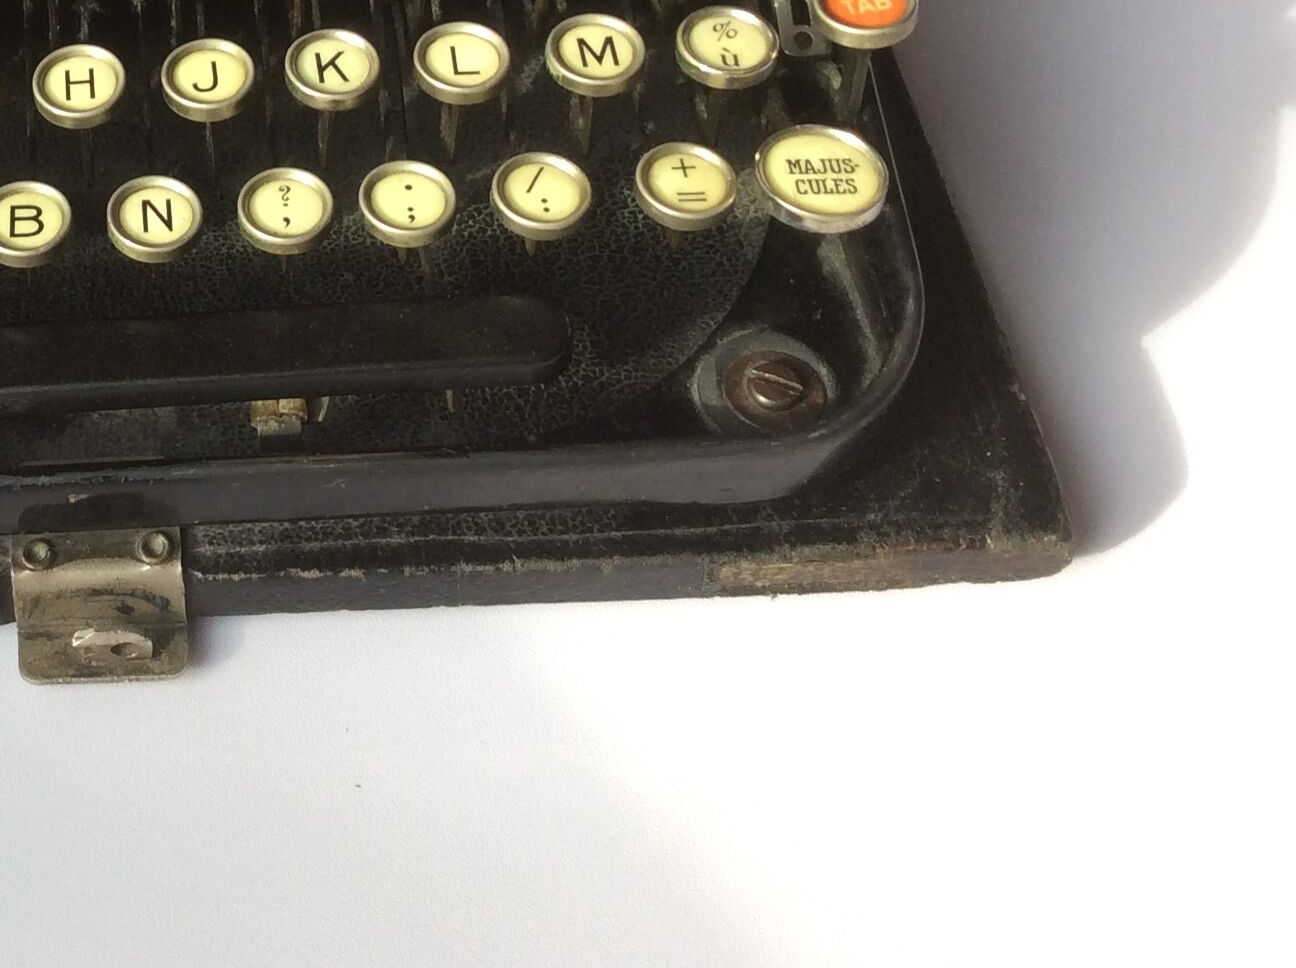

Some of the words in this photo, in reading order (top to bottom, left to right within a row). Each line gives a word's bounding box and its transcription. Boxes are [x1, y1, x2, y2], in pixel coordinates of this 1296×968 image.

[712, 20, 738, 40] %
[314, 50, 350, 84] K
[450, 46, 480, 75] L
[576, 36, 620, 68] M
[64, 68, 96, 101] H
[192, 61, 219, 92] J
[786, 158, 860, 176] MAJUS-
[278, 185, 292, 207] ?
[794, 177, 858, 196] CULES
[9, 204, 45, 238] B
[141, 198, 173, 232] N
